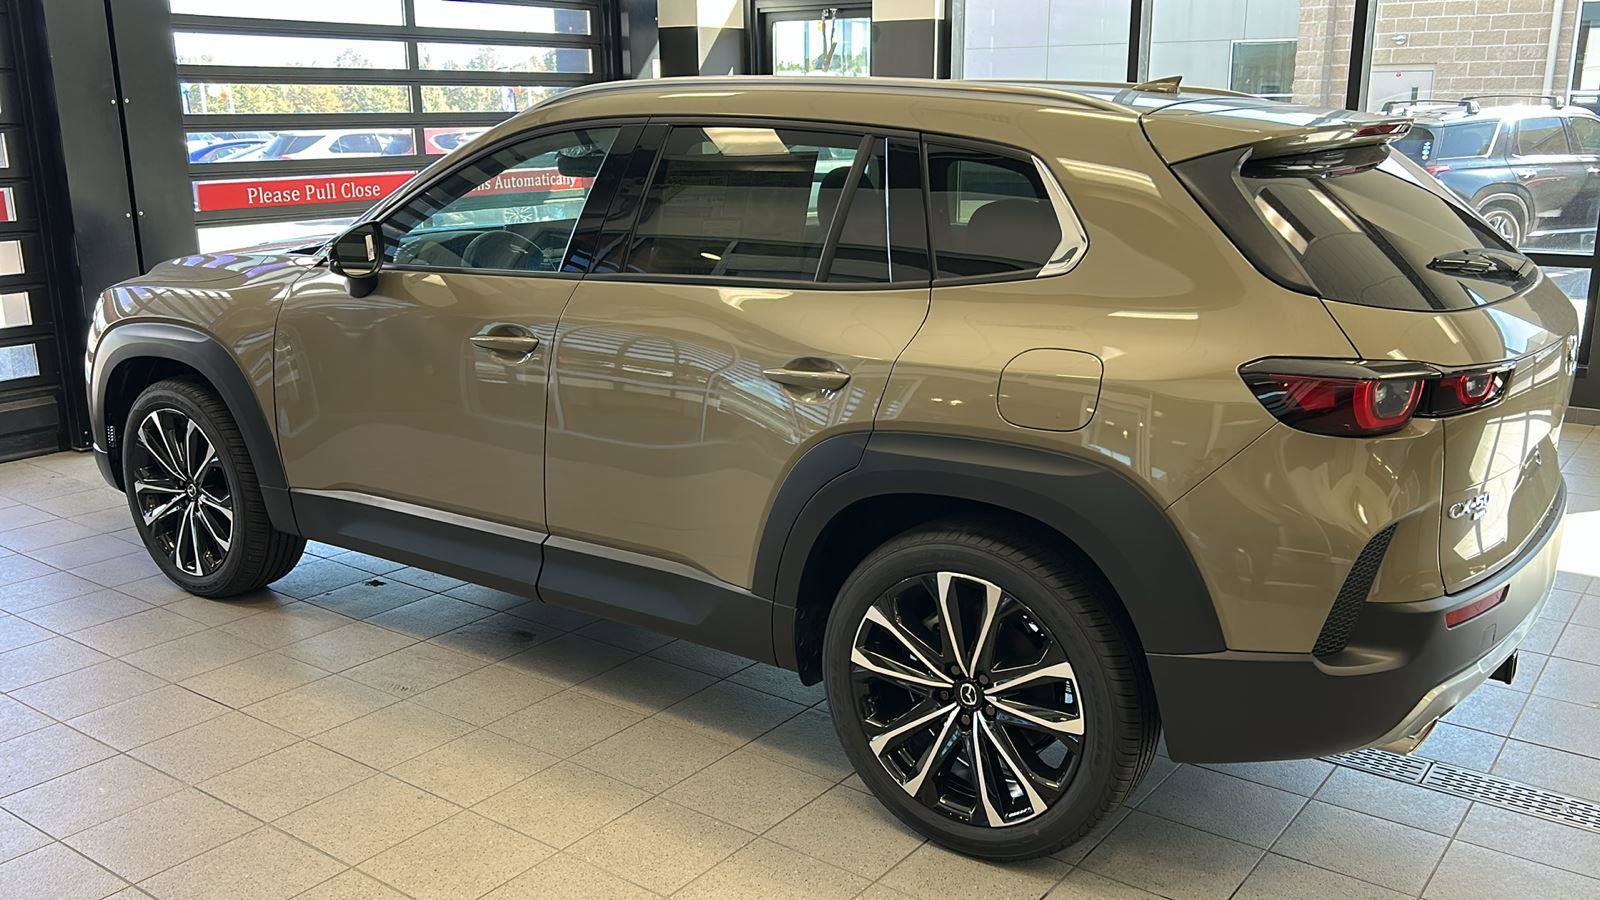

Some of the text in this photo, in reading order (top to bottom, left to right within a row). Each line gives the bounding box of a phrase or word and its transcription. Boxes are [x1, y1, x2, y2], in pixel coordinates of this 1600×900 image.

[494, 173, 576, 190] Automatically
[247, 182, 381, 204] Please Pull Close
